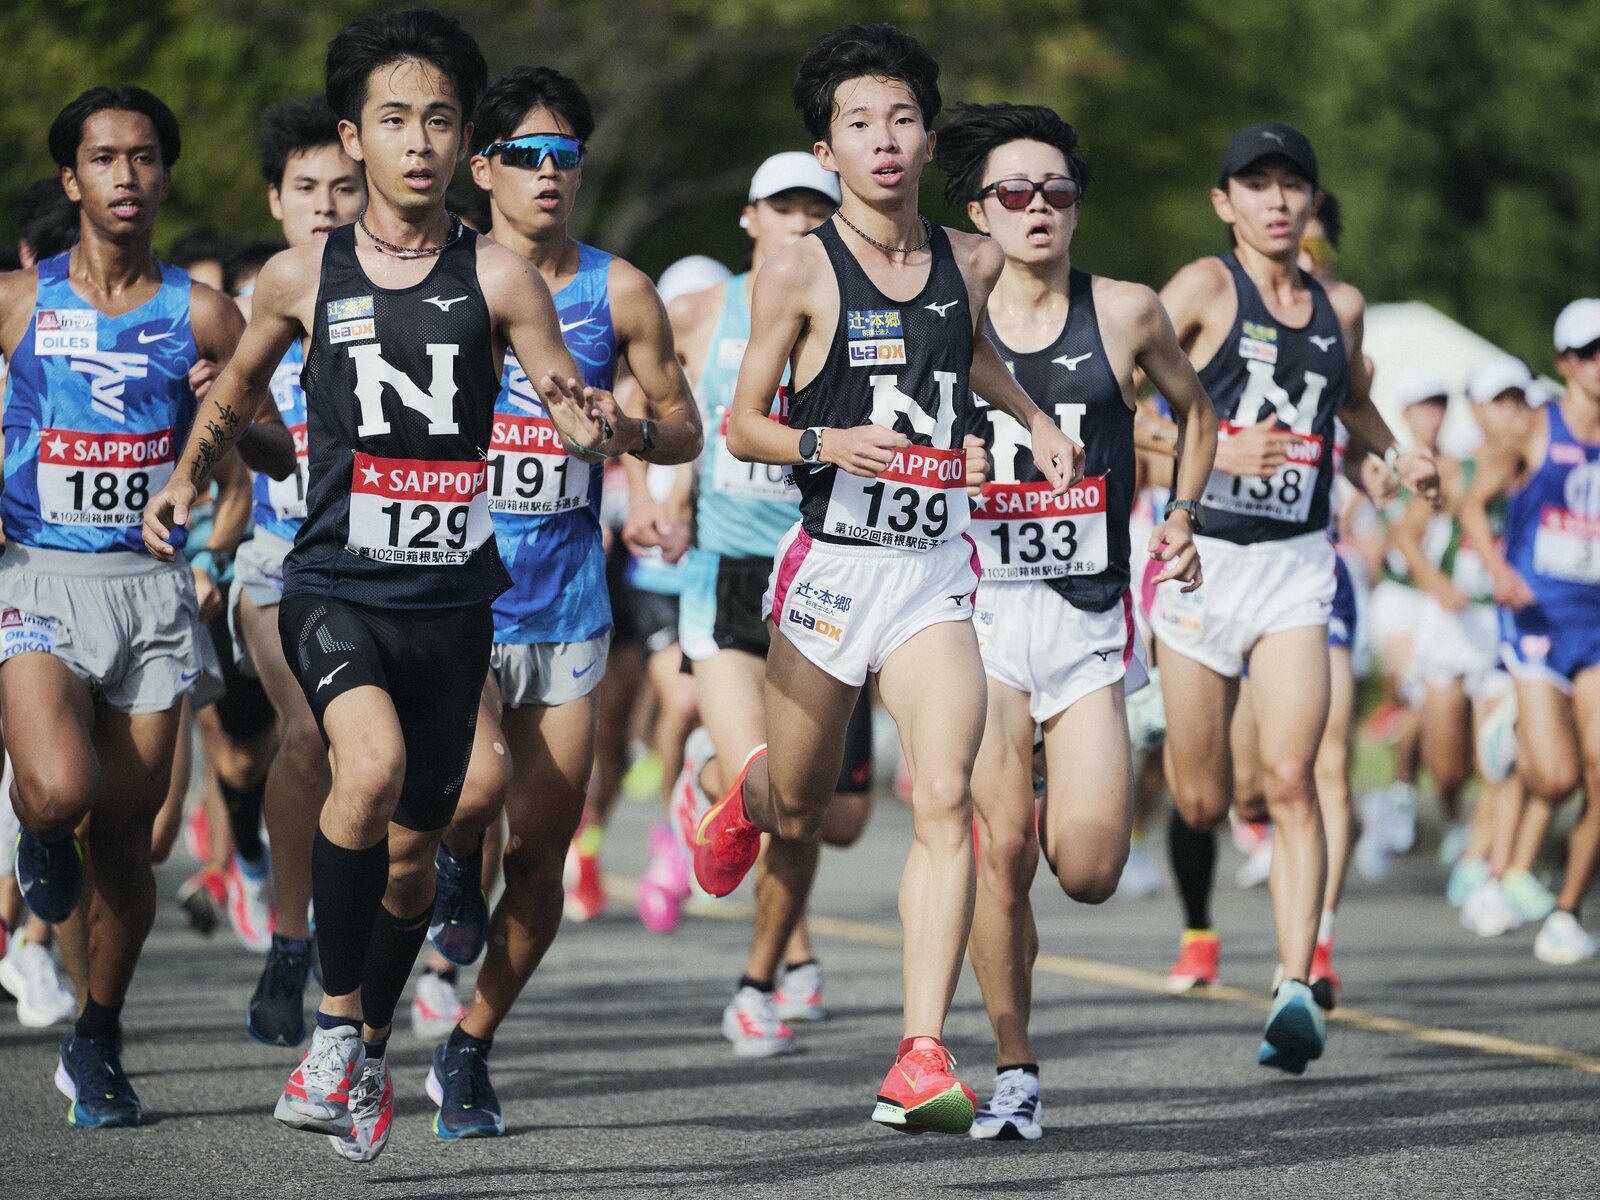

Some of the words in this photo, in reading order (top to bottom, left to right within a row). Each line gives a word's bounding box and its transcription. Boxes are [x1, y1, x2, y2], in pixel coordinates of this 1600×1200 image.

[43, 337, 89, 348] OILES
[348, 343, 459, 437] N
[74, 437, 170, 462] SAPPORO
[487, 454, 569, 498] 191
[886, 452, 962, 481] APPOO
[66, 471, 149, 511] 188
[995, 486, 1099, 513] SAPPORO
[862, 481, 948, 537] 139
[381, 502, 469, 549] 129
[834, 521, 948, 551] 第102回箱根駅伝予
[359, 547, 477, 563] 第102回箱根駅伝予
[990, 520, 1078, 564] 133
[5, 631, 48, 642] OILES
